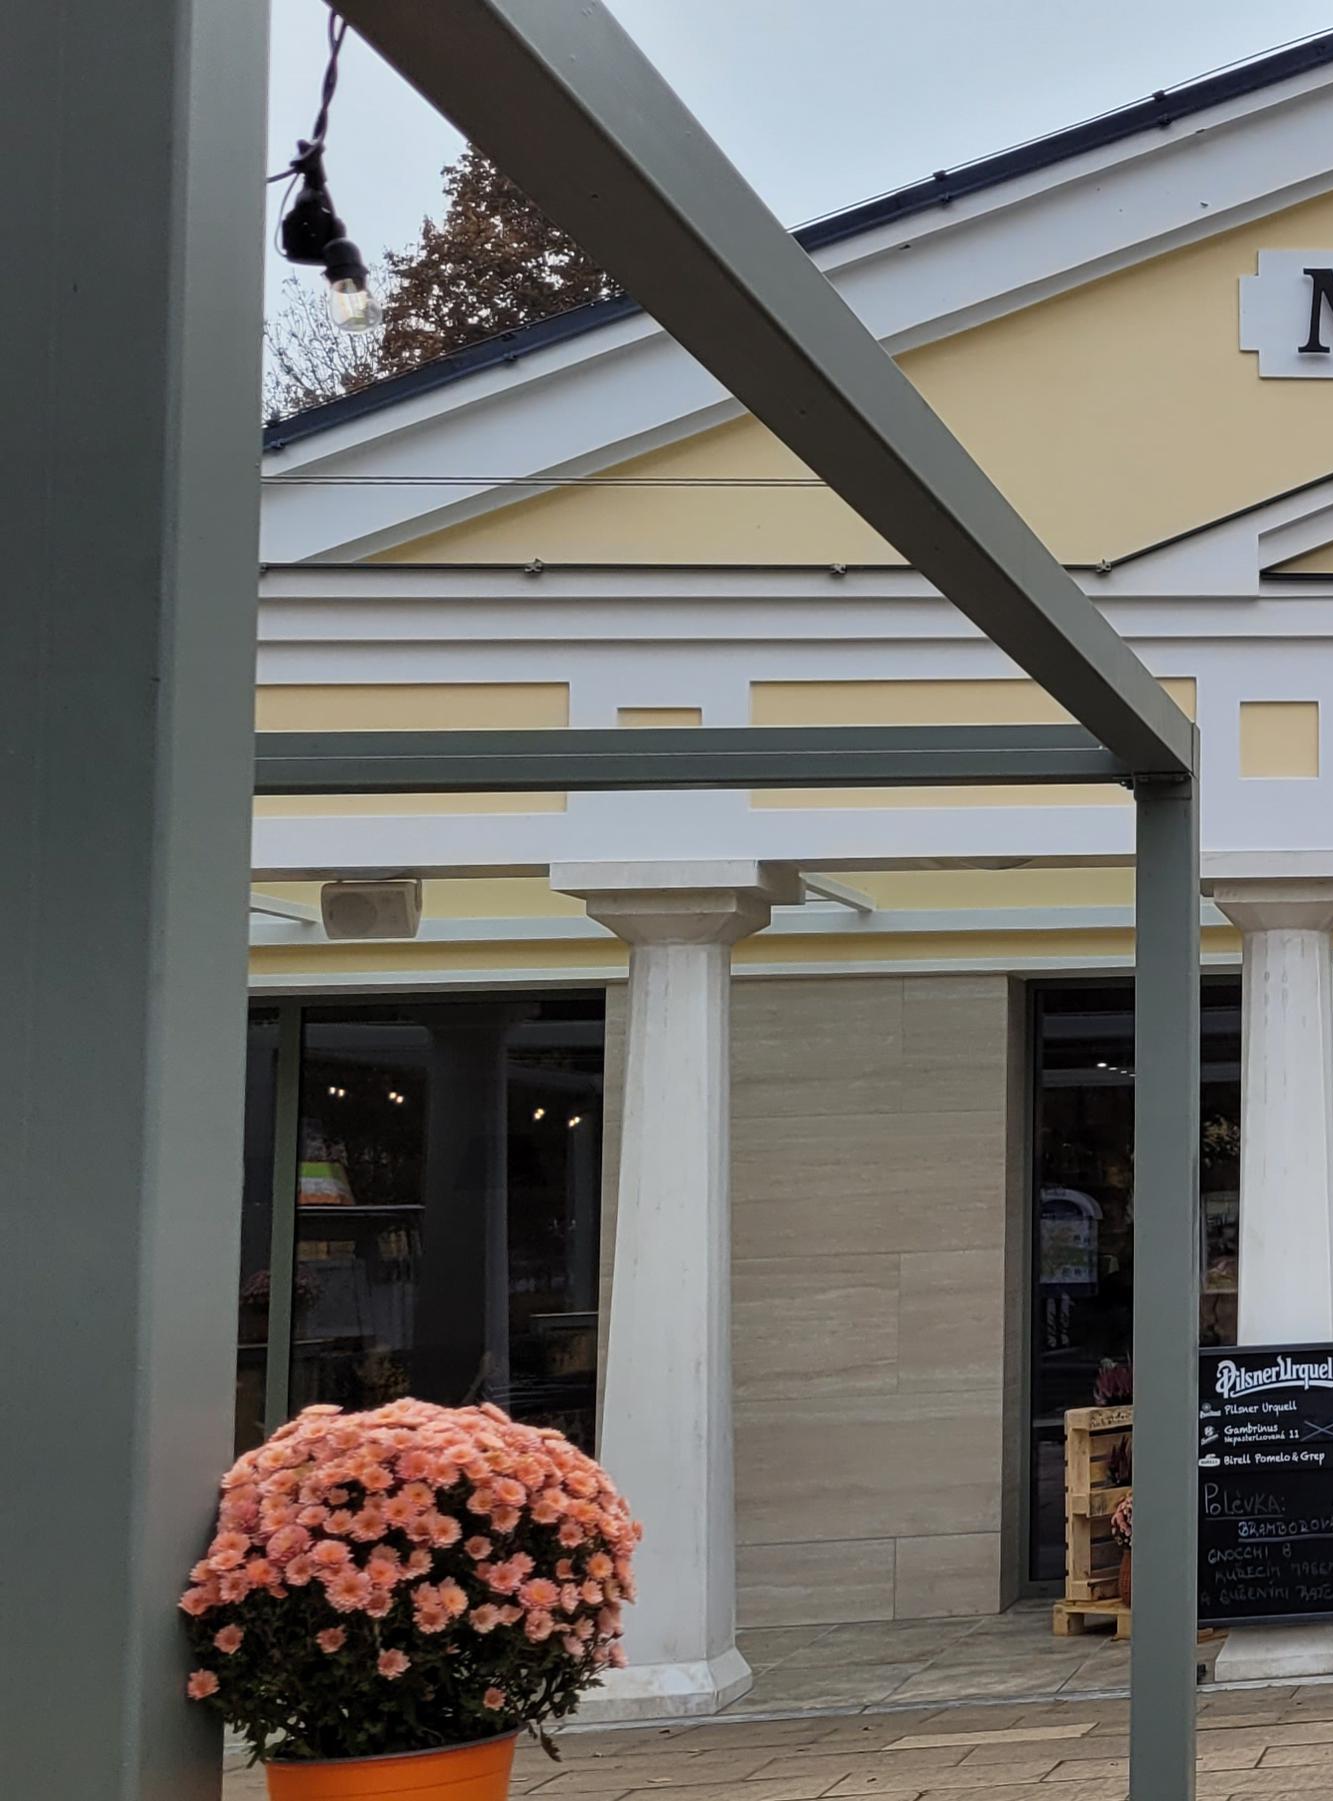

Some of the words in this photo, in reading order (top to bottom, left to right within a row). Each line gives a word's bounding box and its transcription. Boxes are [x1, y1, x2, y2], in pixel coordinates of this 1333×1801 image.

[1215, 1359, 1281, 1399] Pilsner
[1224, 1404, 1259, 1415] Pilsner
[1262, 1400, 1297, 1418] Urquell
[1224, 1421, 1279, 1435] Gambrinus
[1289, 1429, 1299, 1439] 11
[1224, 1454, 1251, 1465] Birell
[1255, 1452, 1290, 1464] Pomelo
[1291, 1452, 1298, 1462] &
[1300, 1451, 1325, 1466] Grep
